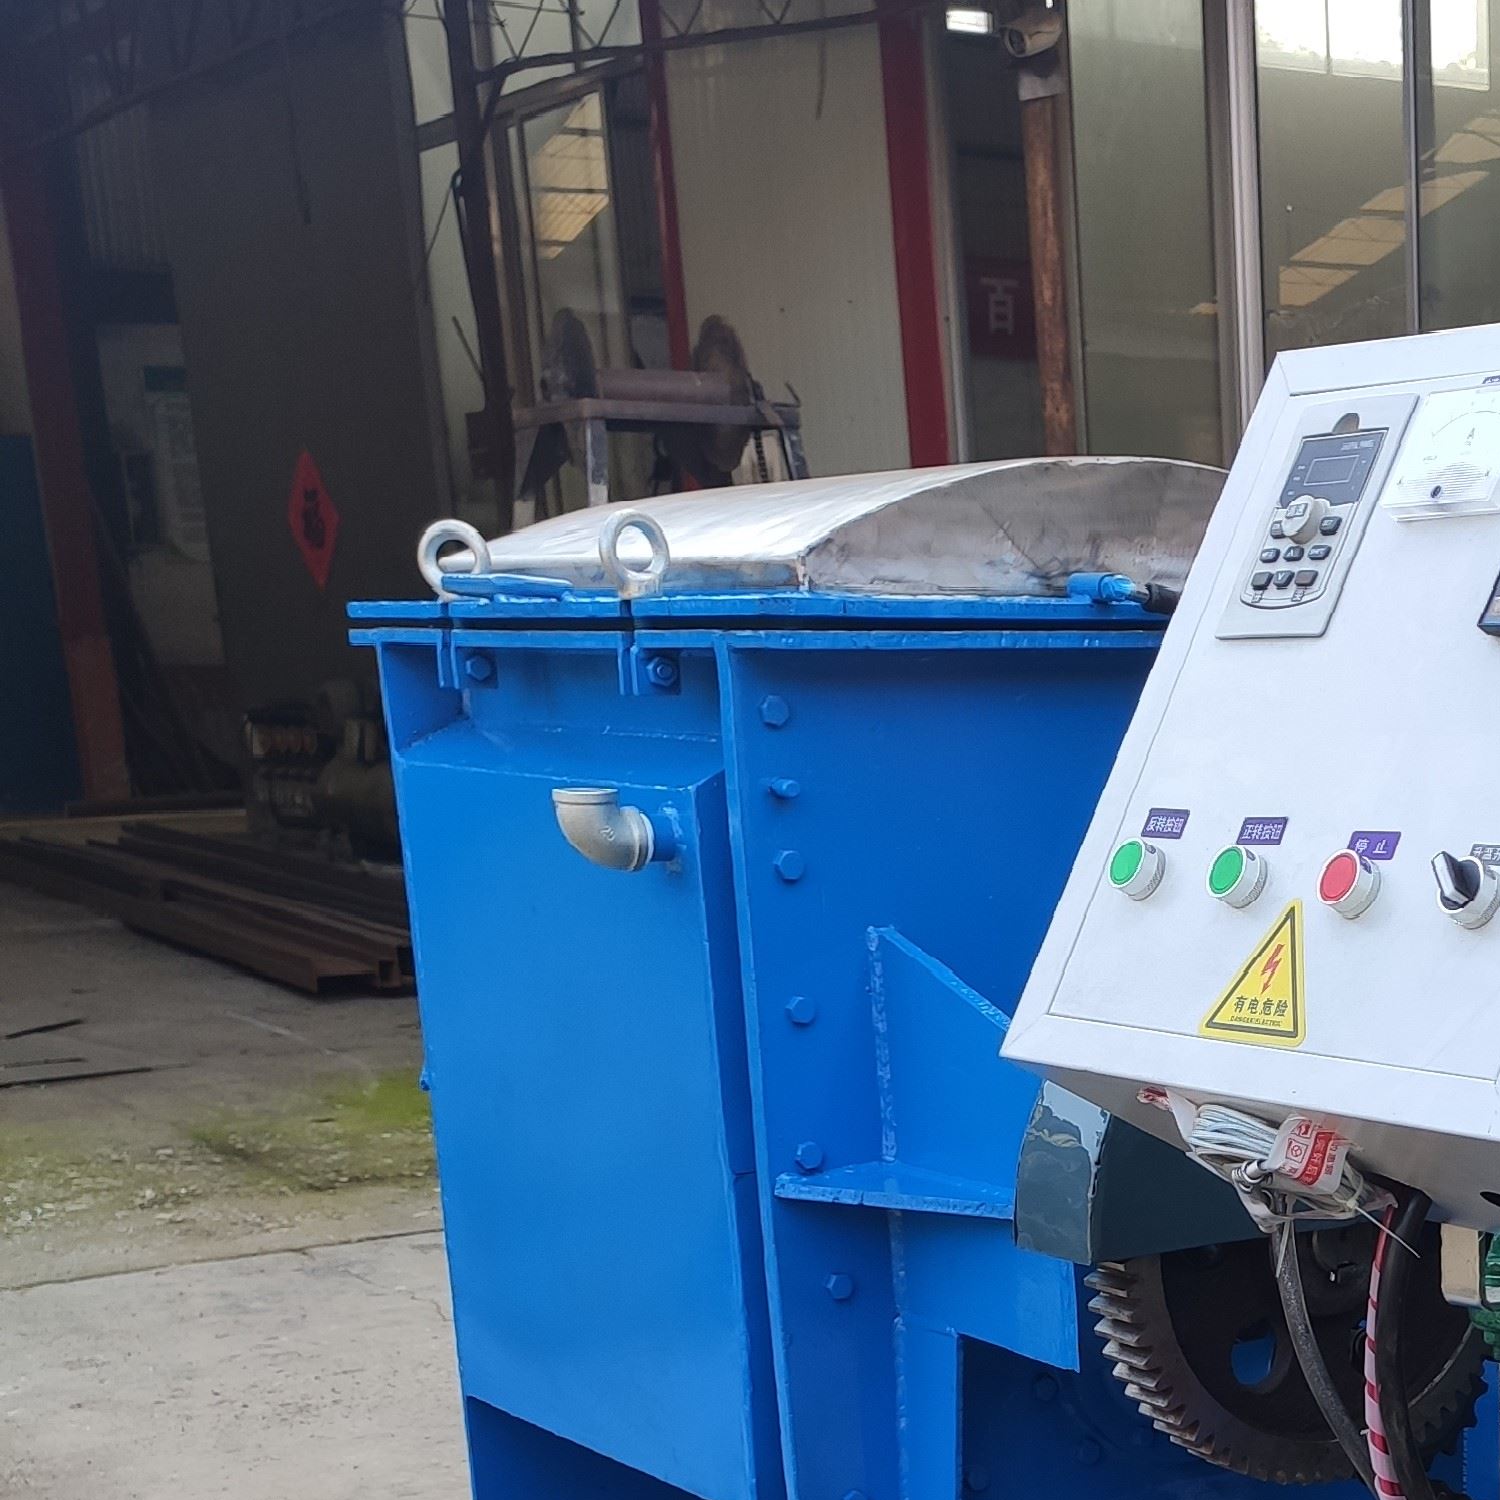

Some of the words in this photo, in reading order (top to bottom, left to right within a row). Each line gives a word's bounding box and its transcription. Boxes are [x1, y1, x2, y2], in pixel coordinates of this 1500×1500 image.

[1146, 815, 1185, 833] 反转按钮
[1240, 822, 1284, 840] 正转按钮
[1354, 838, 1388, 854] 停止
[1233, 995, 1288, 1017] 有电危险
